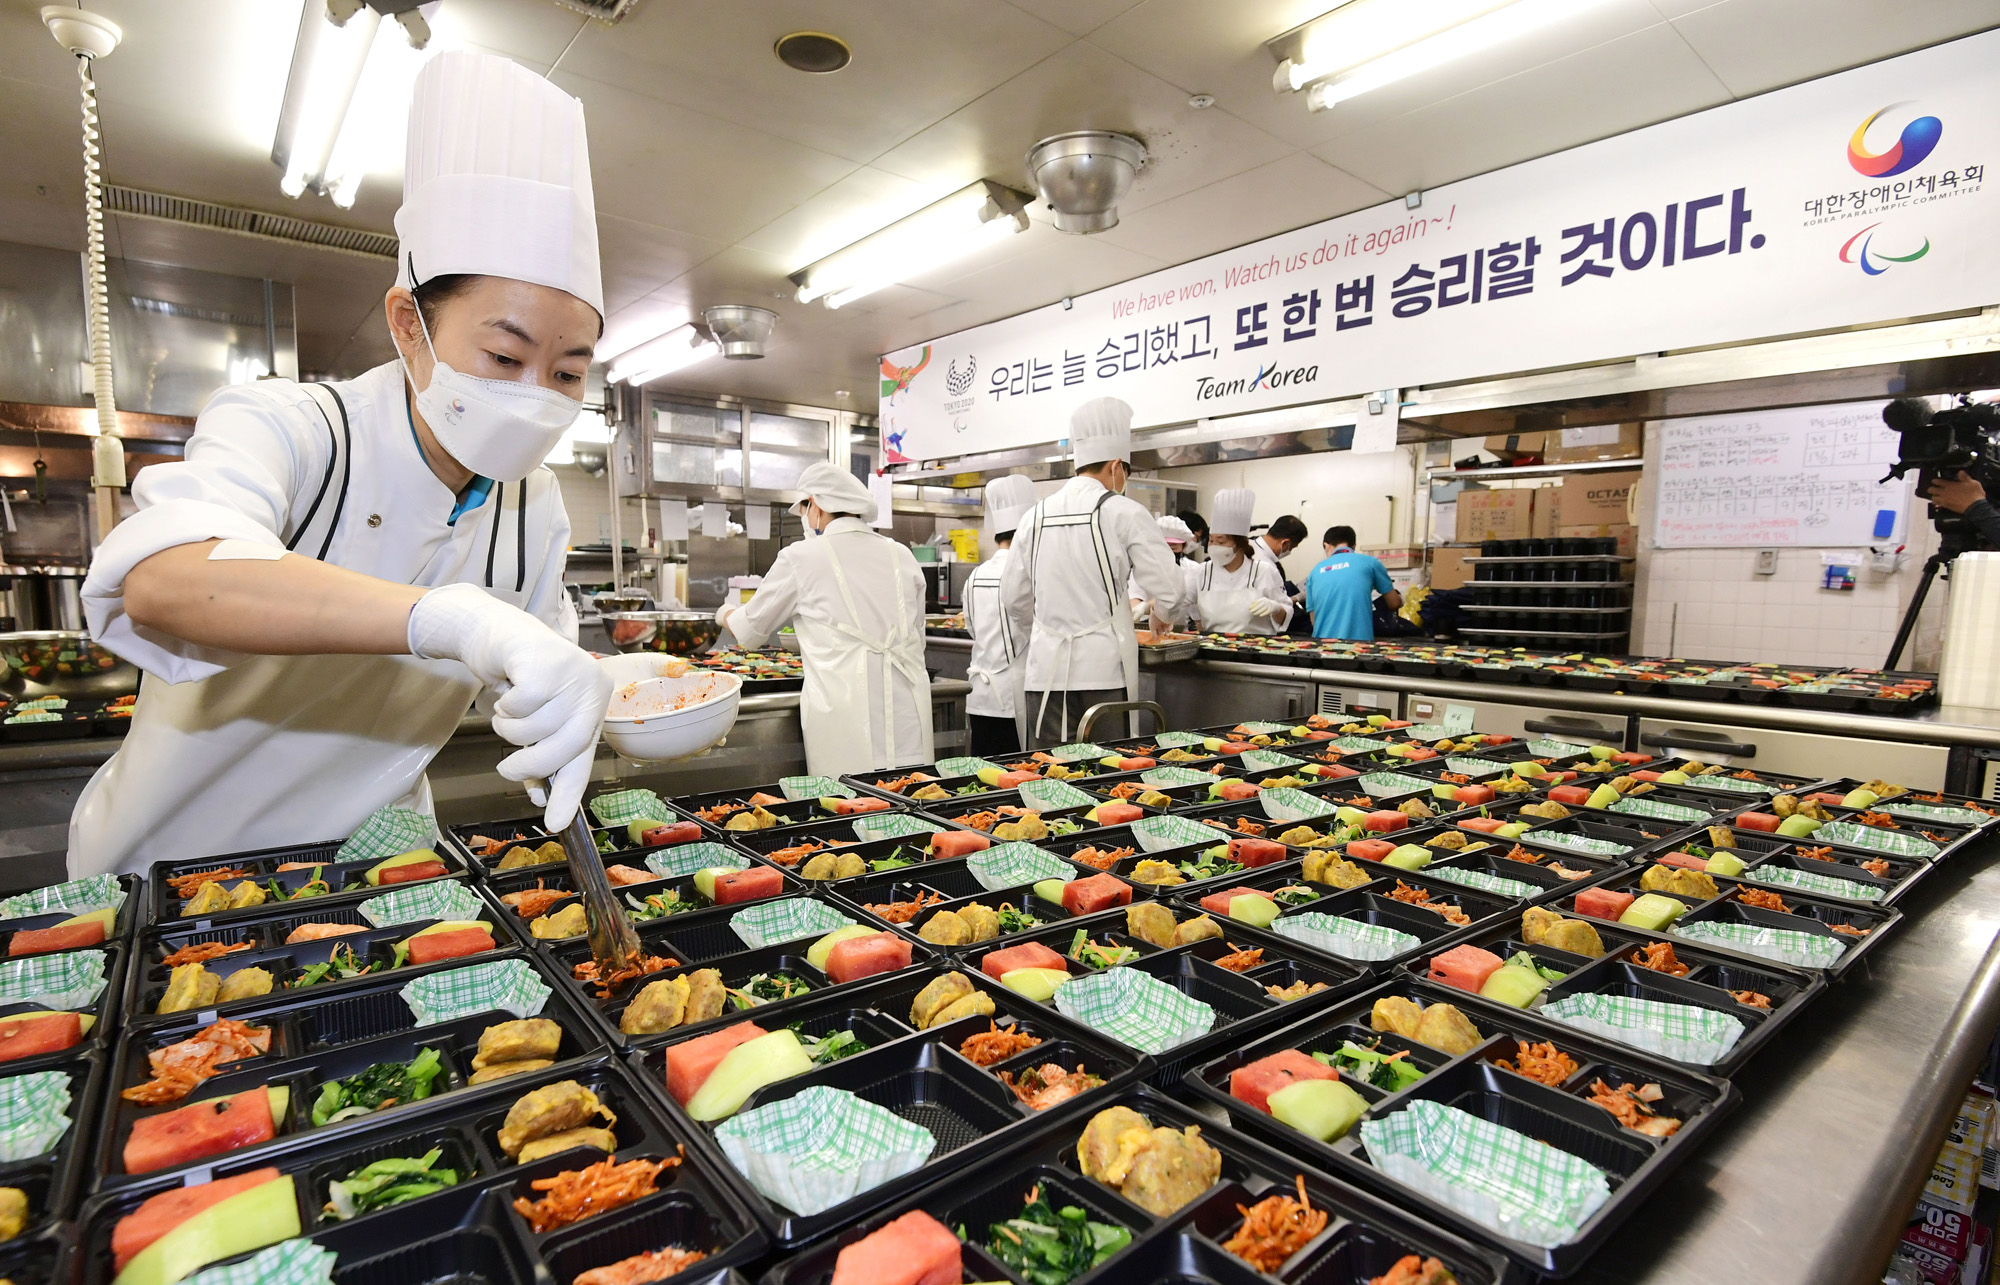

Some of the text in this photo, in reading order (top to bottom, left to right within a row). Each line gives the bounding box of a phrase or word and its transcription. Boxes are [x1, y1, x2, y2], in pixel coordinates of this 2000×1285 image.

[1803, 185, 1982, 227] KOREA PARALYMPIC COMMITTEE
[1804, 165, 1984, 217] 대한장애인체육회
[988, 187, 1766, 402] 우리는 늘 승리했고, 또 한 번 승리할 것이다.
[1112, 299, 1134, 320] We
[1137, 290, 1176, 313] have
[1179, 279, 1217, 302] won,
[1224, 255, 1280, 290] Watch
[1285, 252, 1308, 273] us
[1312, 239, 1339, 266] do
[1344, 233, 1359, 258] it
[1196, 360, 1319, 401] Team Korea
[944, 397, 975, 411] TOKYO 2020
[1319, 561, 1350, 574] KOREA
